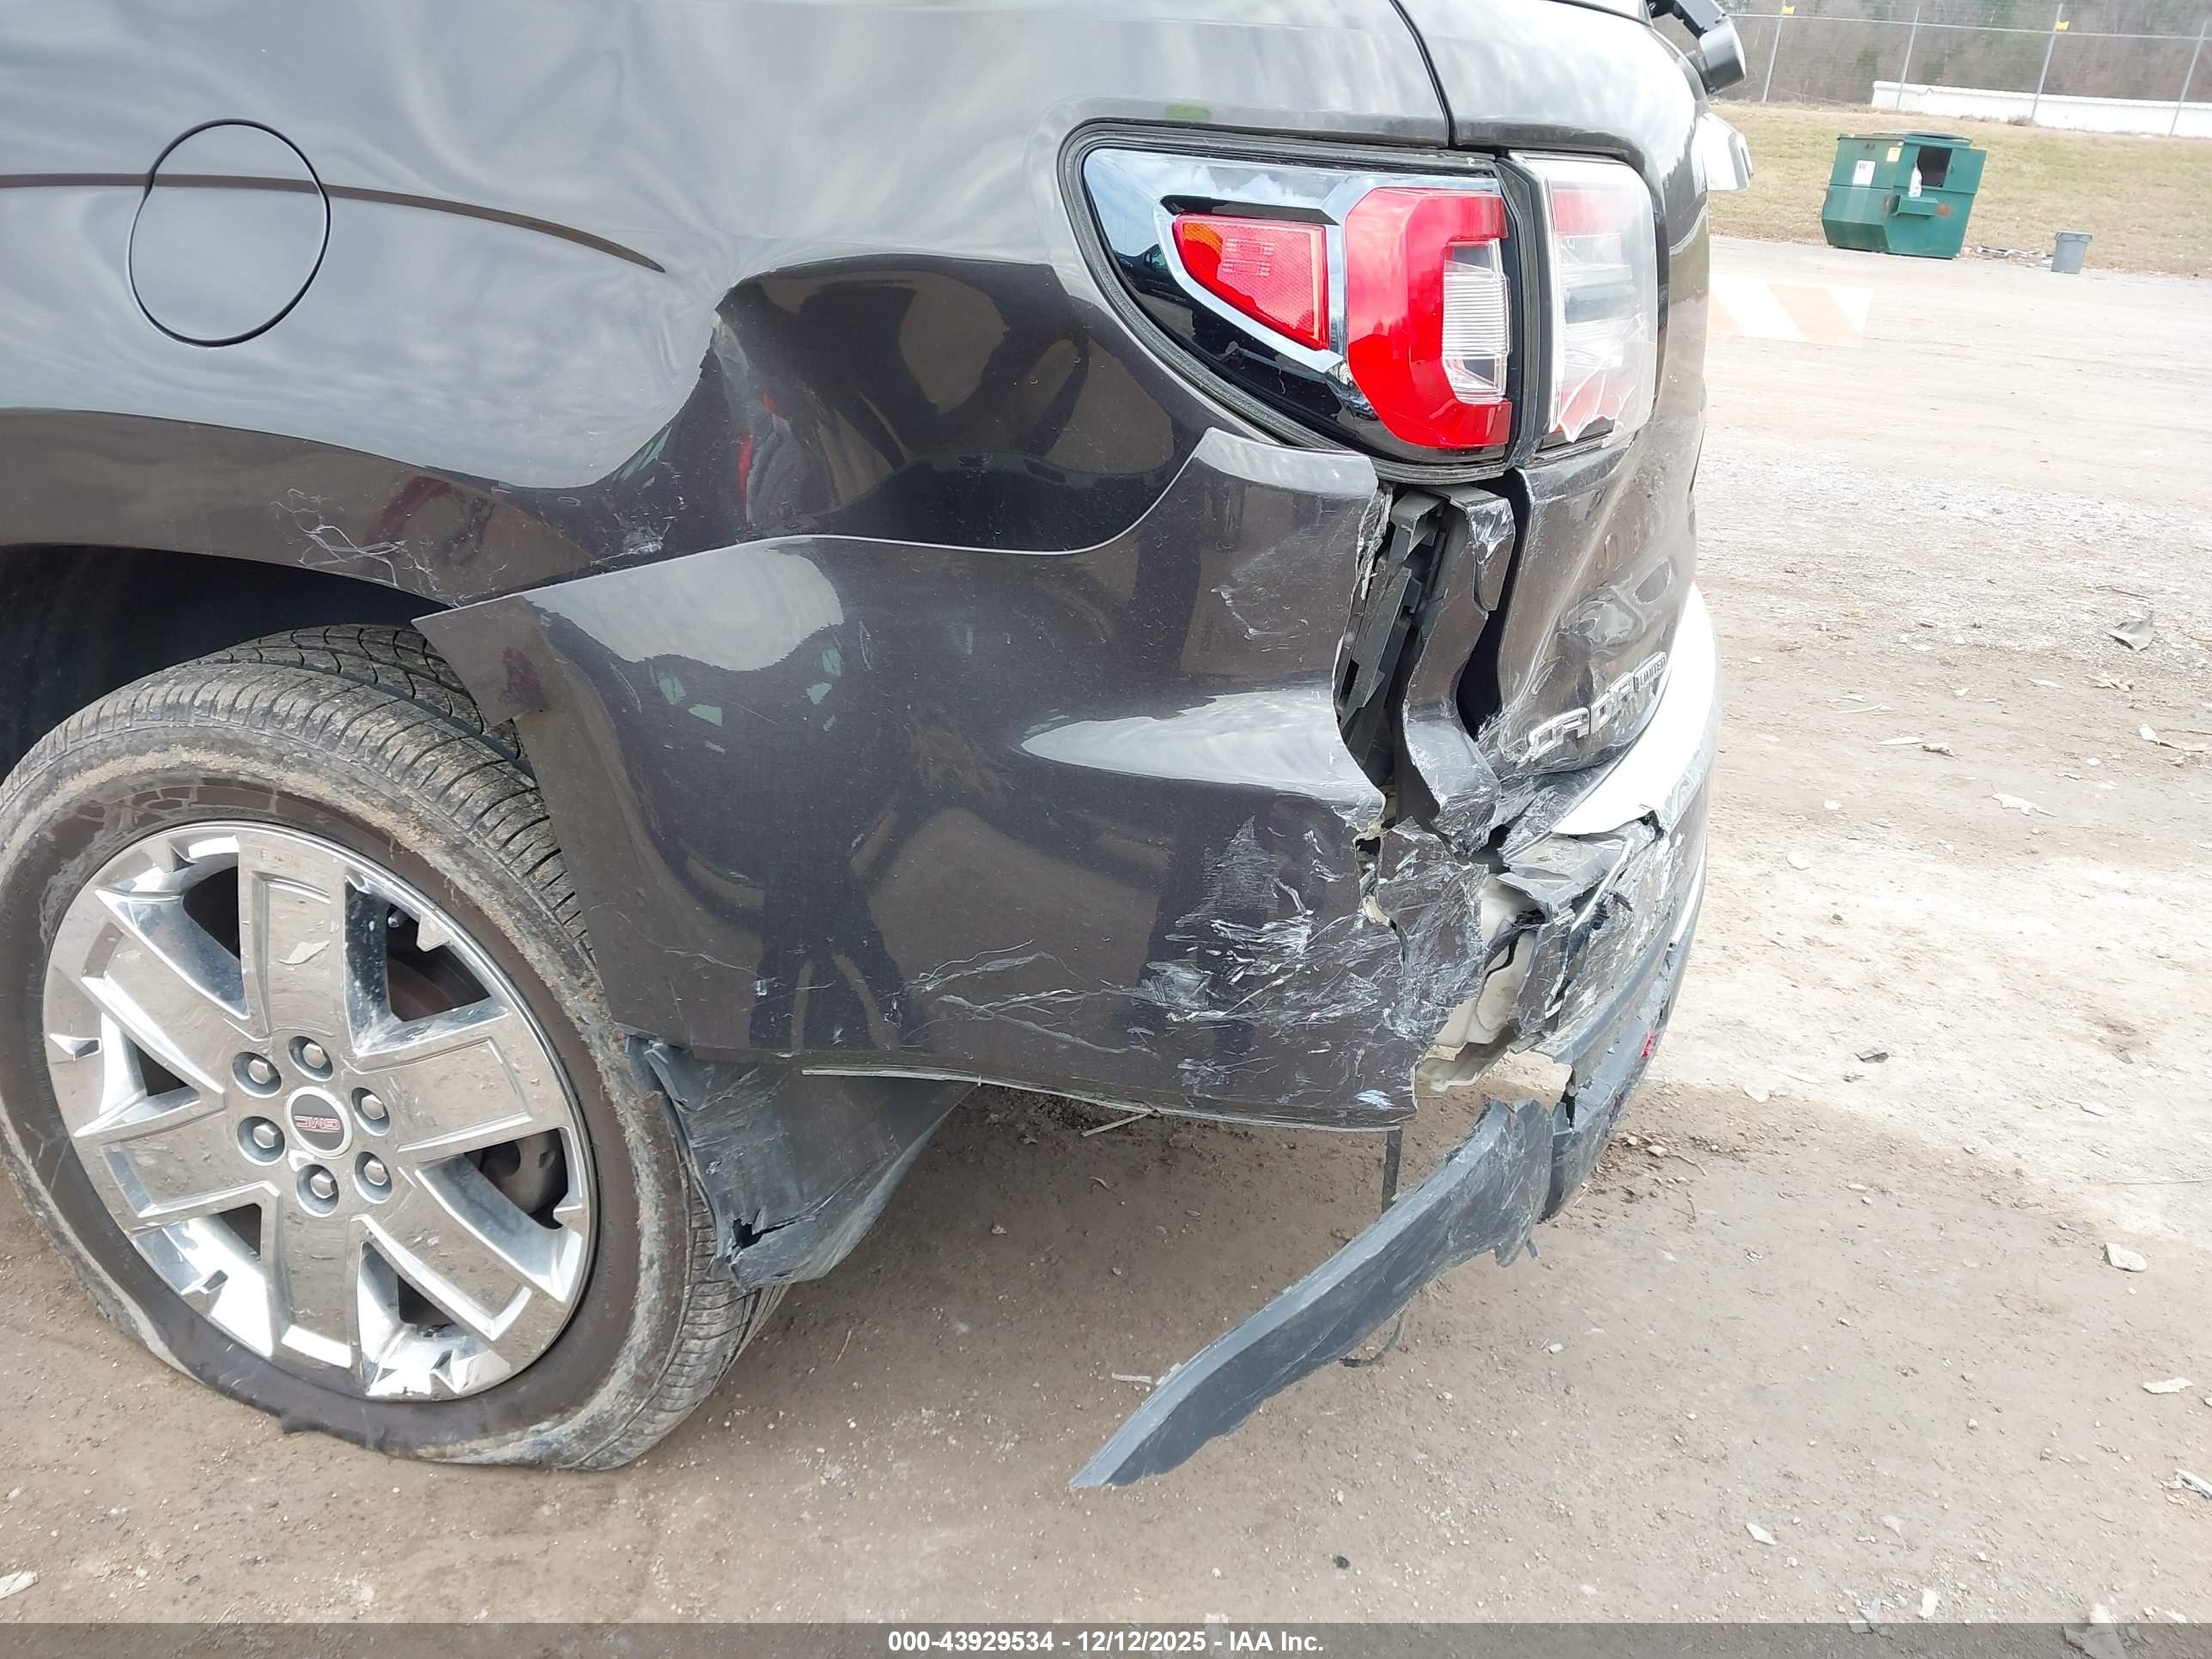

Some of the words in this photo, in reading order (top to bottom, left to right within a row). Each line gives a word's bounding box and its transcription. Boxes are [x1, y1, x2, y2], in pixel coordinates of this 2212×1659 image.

[1638, 653, 1668, 687] LIMITED
[1504, 672, 1636, 763] CADIA
[294, 1115, 342, 1132] GMC
